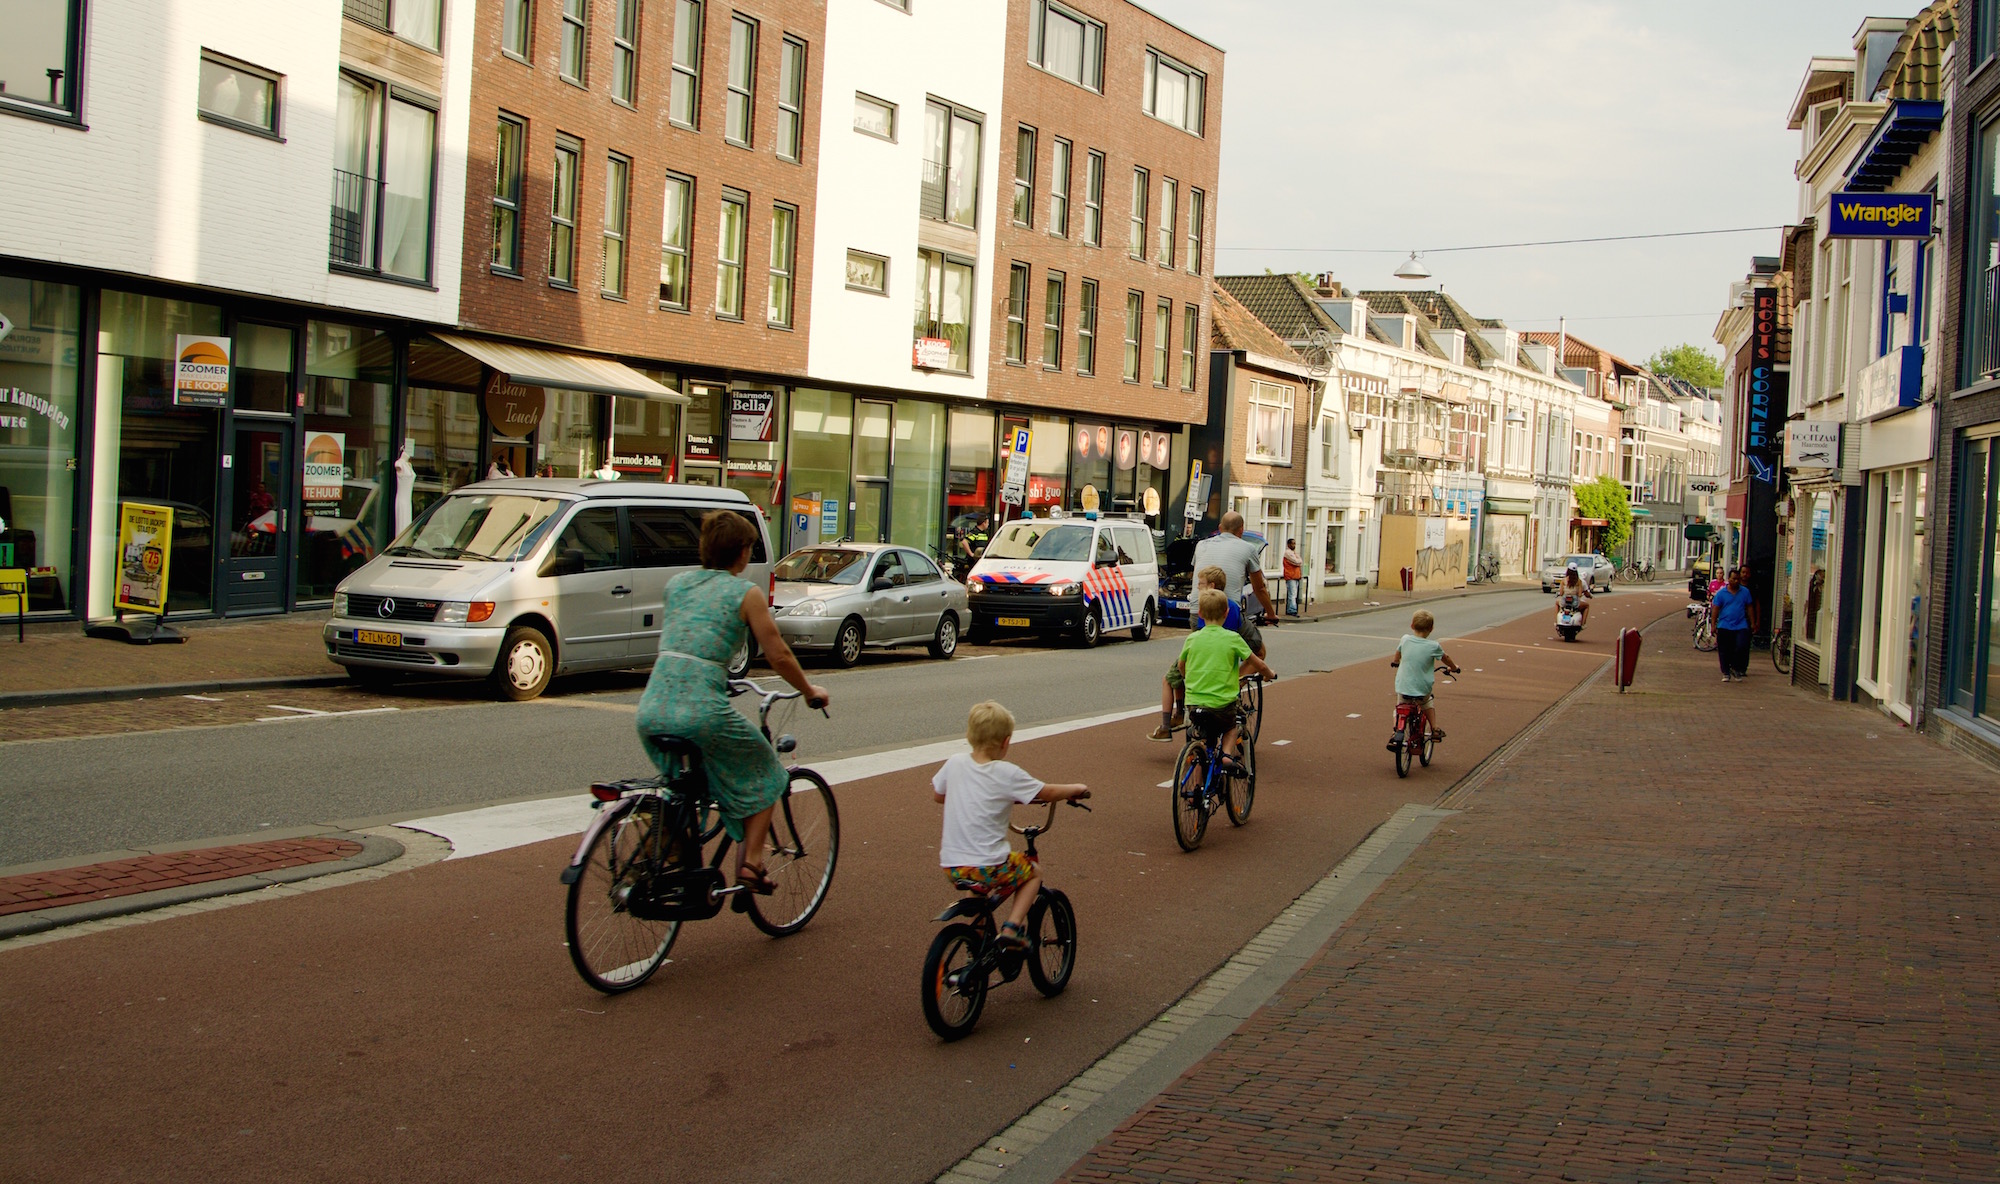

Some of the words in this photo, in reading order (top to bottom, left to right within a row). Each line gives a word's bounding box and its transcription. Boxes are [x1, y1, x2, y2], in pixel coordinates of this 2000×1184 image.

[1838, 202, 1923, 228] Wrangler
[1757, 296, 1774, 359] ROOTS
[180, 364, 227, 375] ZOOMER
[180, 380, 193, 389] TE
[194, 381, 227, 391] KOOP
[488, 374, 528, 397] Asian
[732, 391, 772, 400] Haarmode
[11, 386, 70, 430] Kansspelen
[732, 399, 767, 412] Bella
[1750, 366, 1770, 447] CORNER
[505, 402, 538, 425] Touch
[687, 434, 708, 444] Dames
[708, 435, 714, 444] &
[1017, 432, 1027, 451] P
[690, 445, 710, 455] Heren
[612, 454, 643, 465] aarmode
[644, 455, 662, 467] Bella
[757, 461, 773, 472] Bella
[305, 465, 341, 476] ZOOMER
[305, 487, 315, 498] TE
[316, 487, 341, 498] HUUR
[1045, 486, 1062, 502] guo
[128, 515, 135, 523] DE
[135, 516, 149, 525] LOTTO
[149, 518, 167, 528] JACKPOT
[799, 515, 807, 528] P
[136, 524, 151, 534] STAAT
[360, 631, 398, 645] 2-TLN-08
